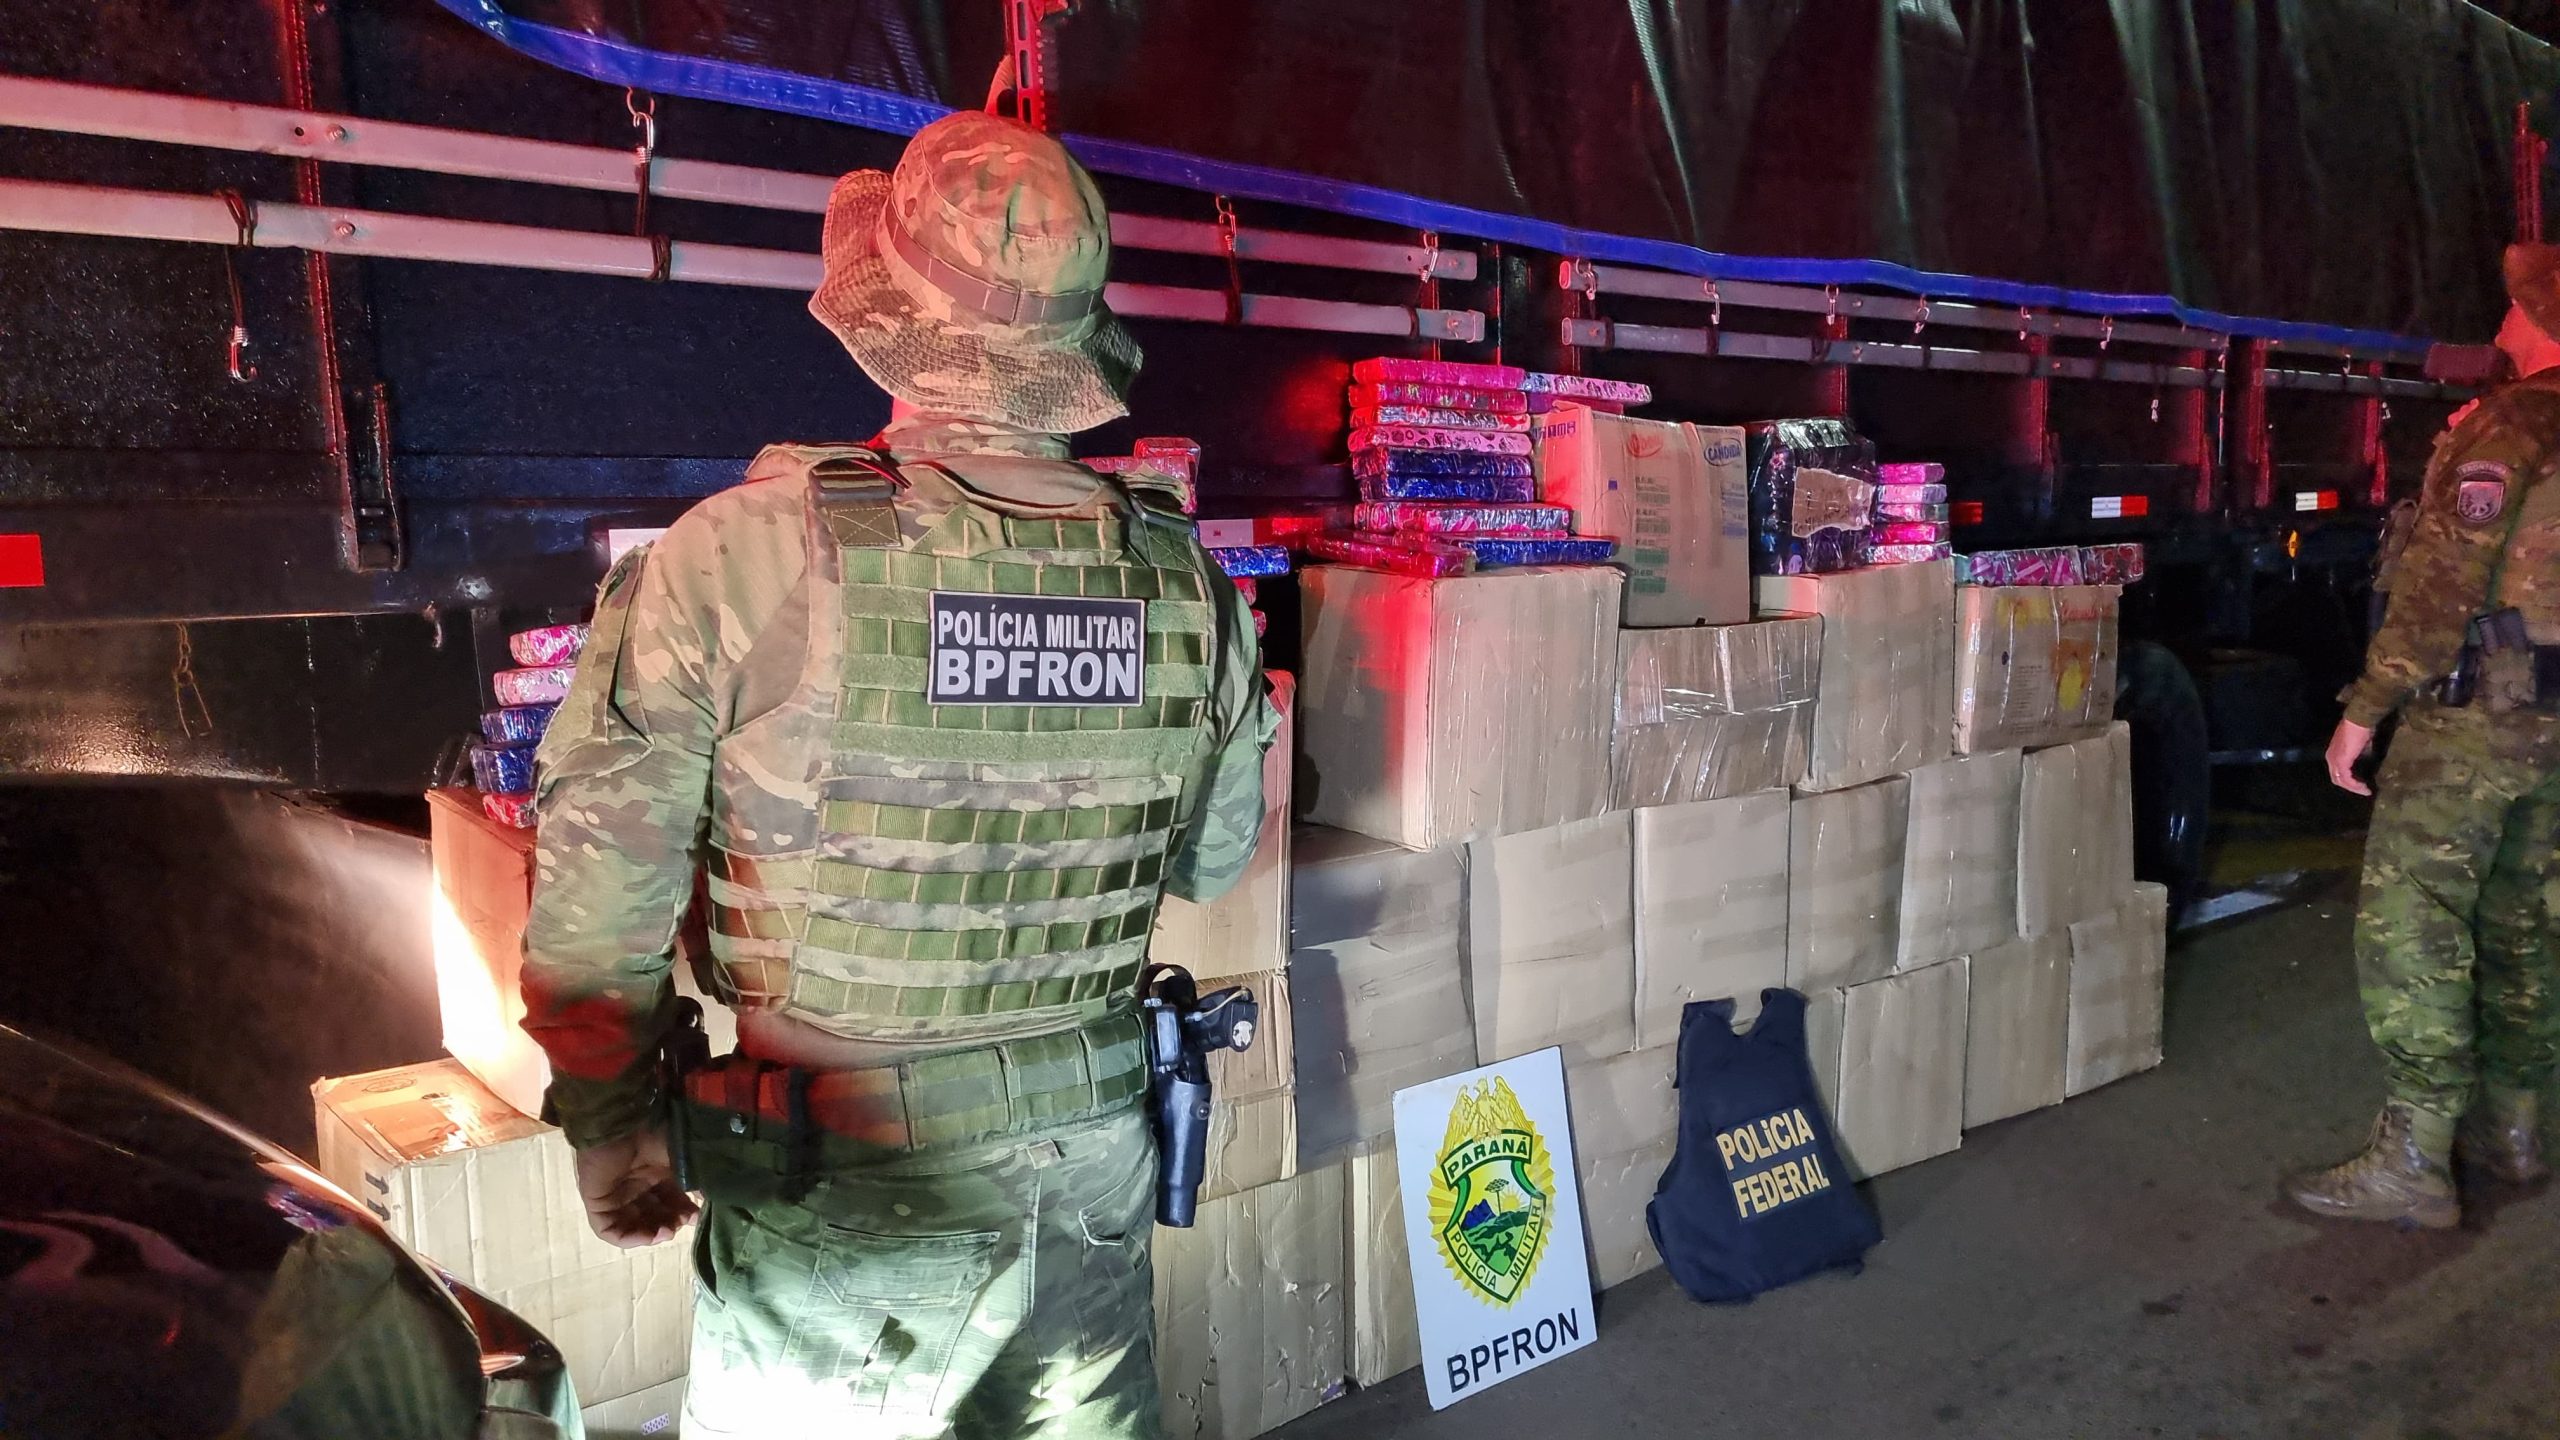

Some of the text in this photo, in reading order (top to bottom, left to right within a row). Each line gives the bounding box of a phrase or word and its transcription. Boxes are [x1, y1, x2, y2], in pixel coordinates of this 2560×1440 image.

[938, 604, 1136, 650] POLÍCIA MILITAR
[936, 648, 1136, 697] BPFRON
[1449, 1137, 1529, 1180] PARANÁ
[1732, 1153, 1831, 1218] FEDERAL
[1509, 1205, 1542, 1281] MILITAR
[1447, 1308, 1580, 1393] BPFRON
